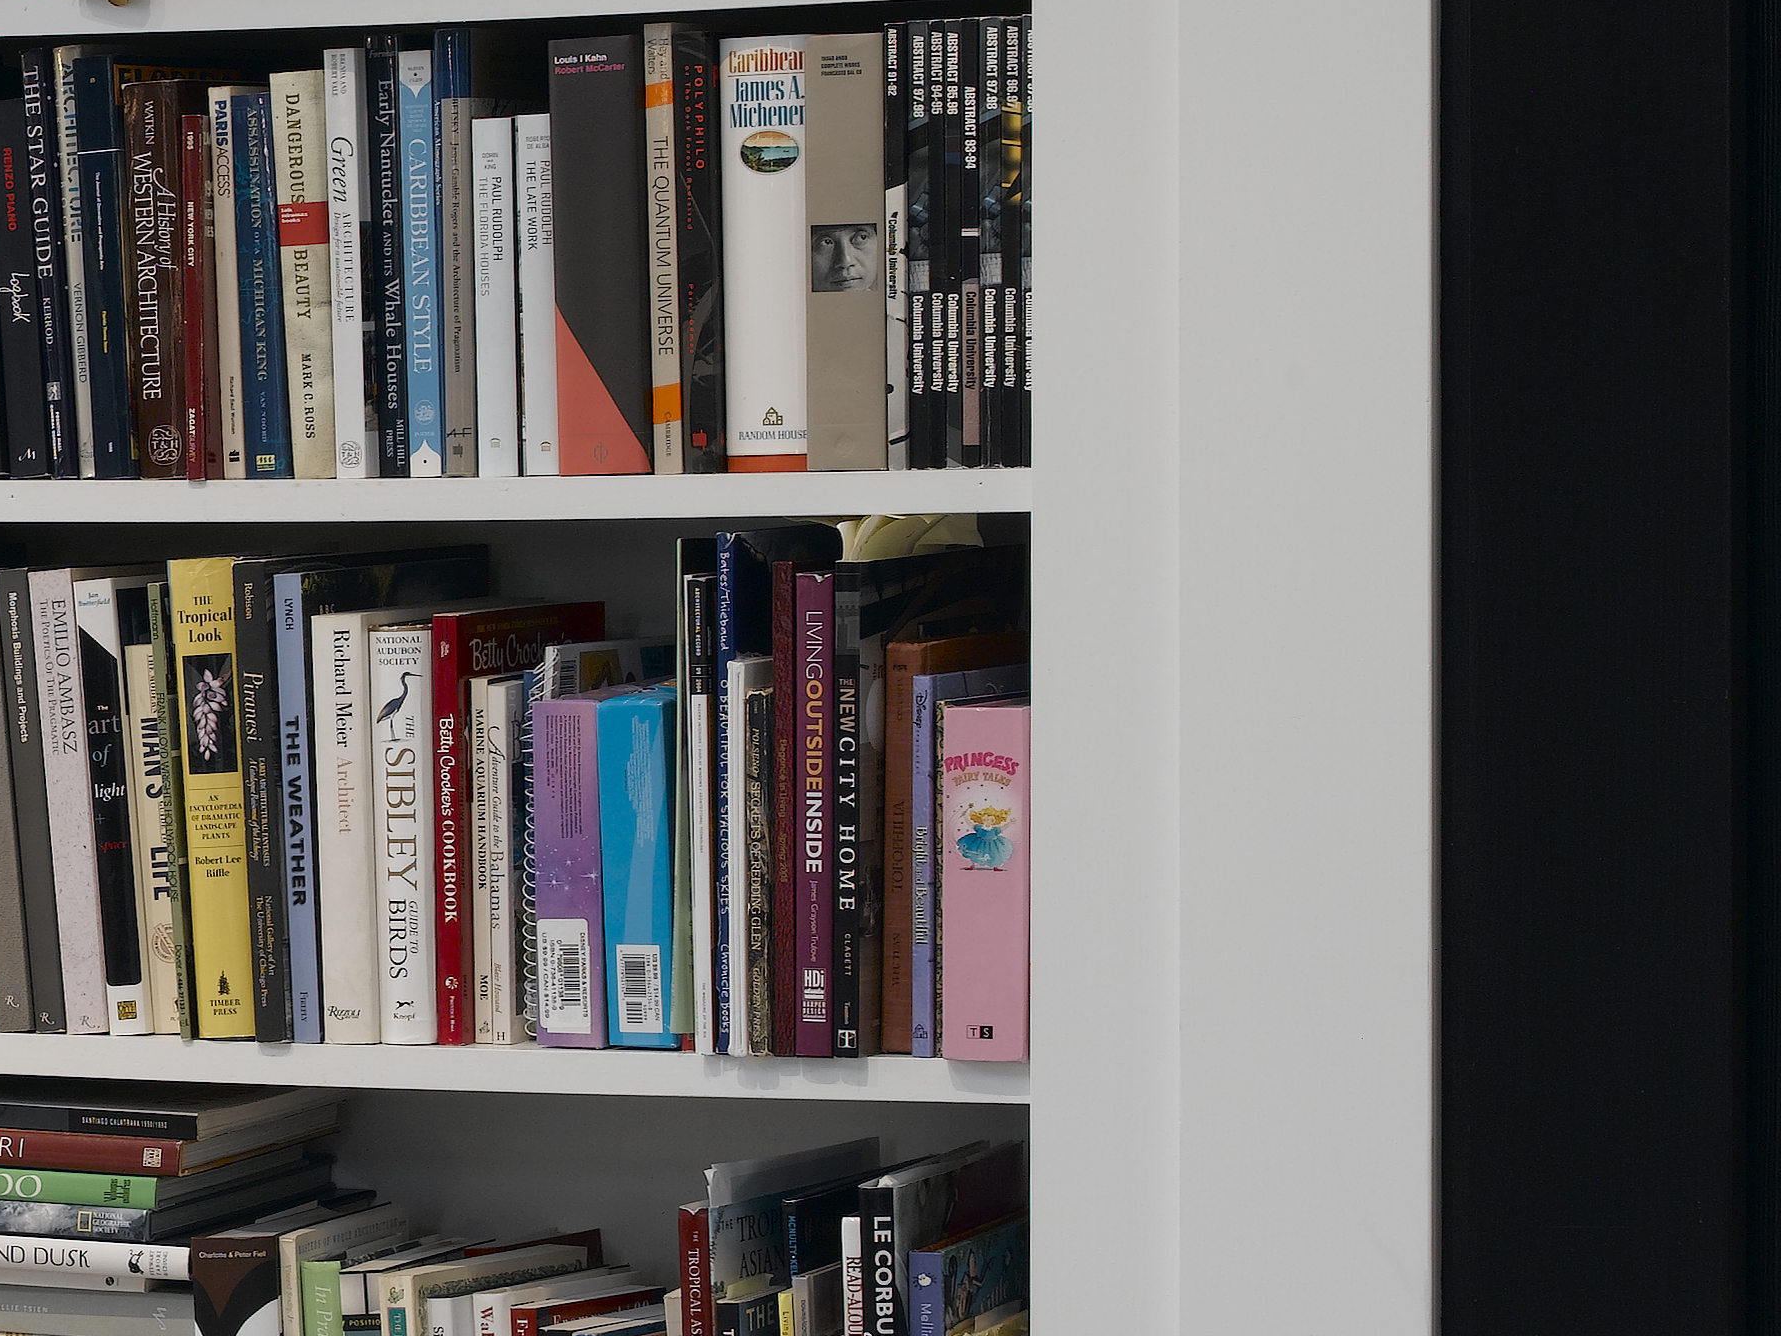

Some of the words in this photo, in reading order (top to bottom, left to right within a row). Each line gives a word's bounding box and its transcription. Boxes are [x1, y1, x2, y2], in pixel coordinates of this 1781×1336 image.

[408, 139, 430, 287] CARIBBEAN
[412, 293, 433, 375] STYLE
[285, 715, 299, 766] THE
[944, 750, 1020, 776] PRINCESS
[287, 775, 307, 907] WEATHER
[385, 747, 419, 891] SIBLEY
[386, 898, 409, 980] BIRDS
[873, 1214, 891, 1244] LE
